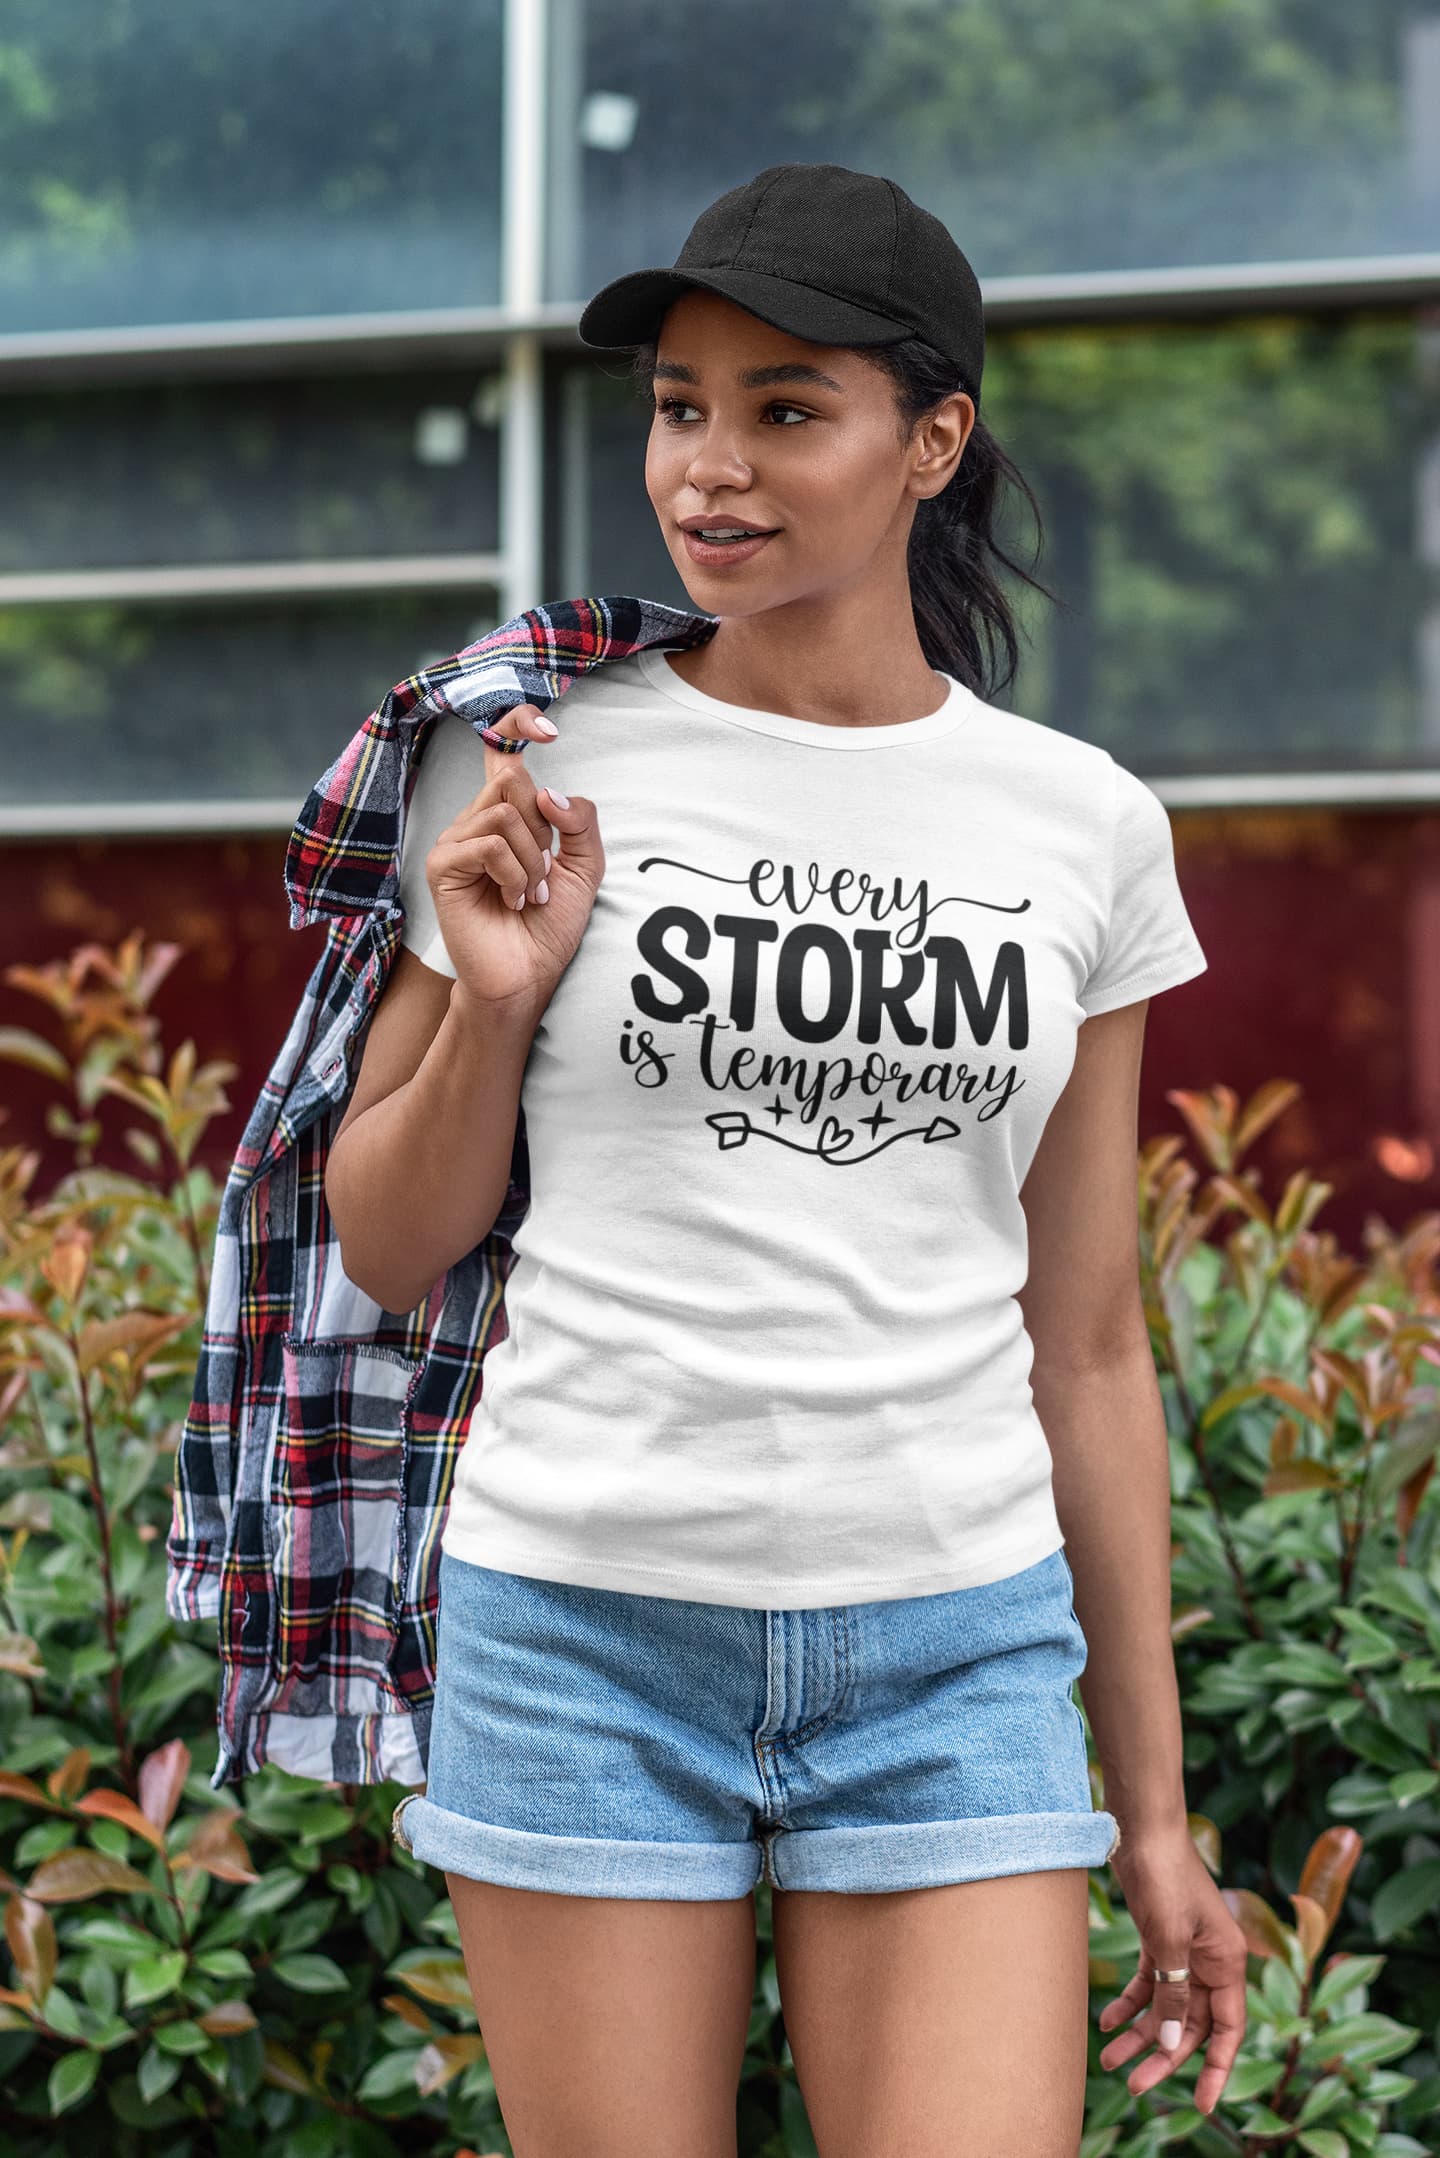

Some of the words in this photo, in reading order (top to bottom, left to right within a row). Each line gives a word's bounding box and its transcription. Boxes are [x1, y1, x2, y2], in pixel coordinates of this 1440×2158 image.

[630, 905, 1029, 1051] STORM
[619, 1019, 676, 1089] is
[689, 1013, 1026, 1125] temporary
